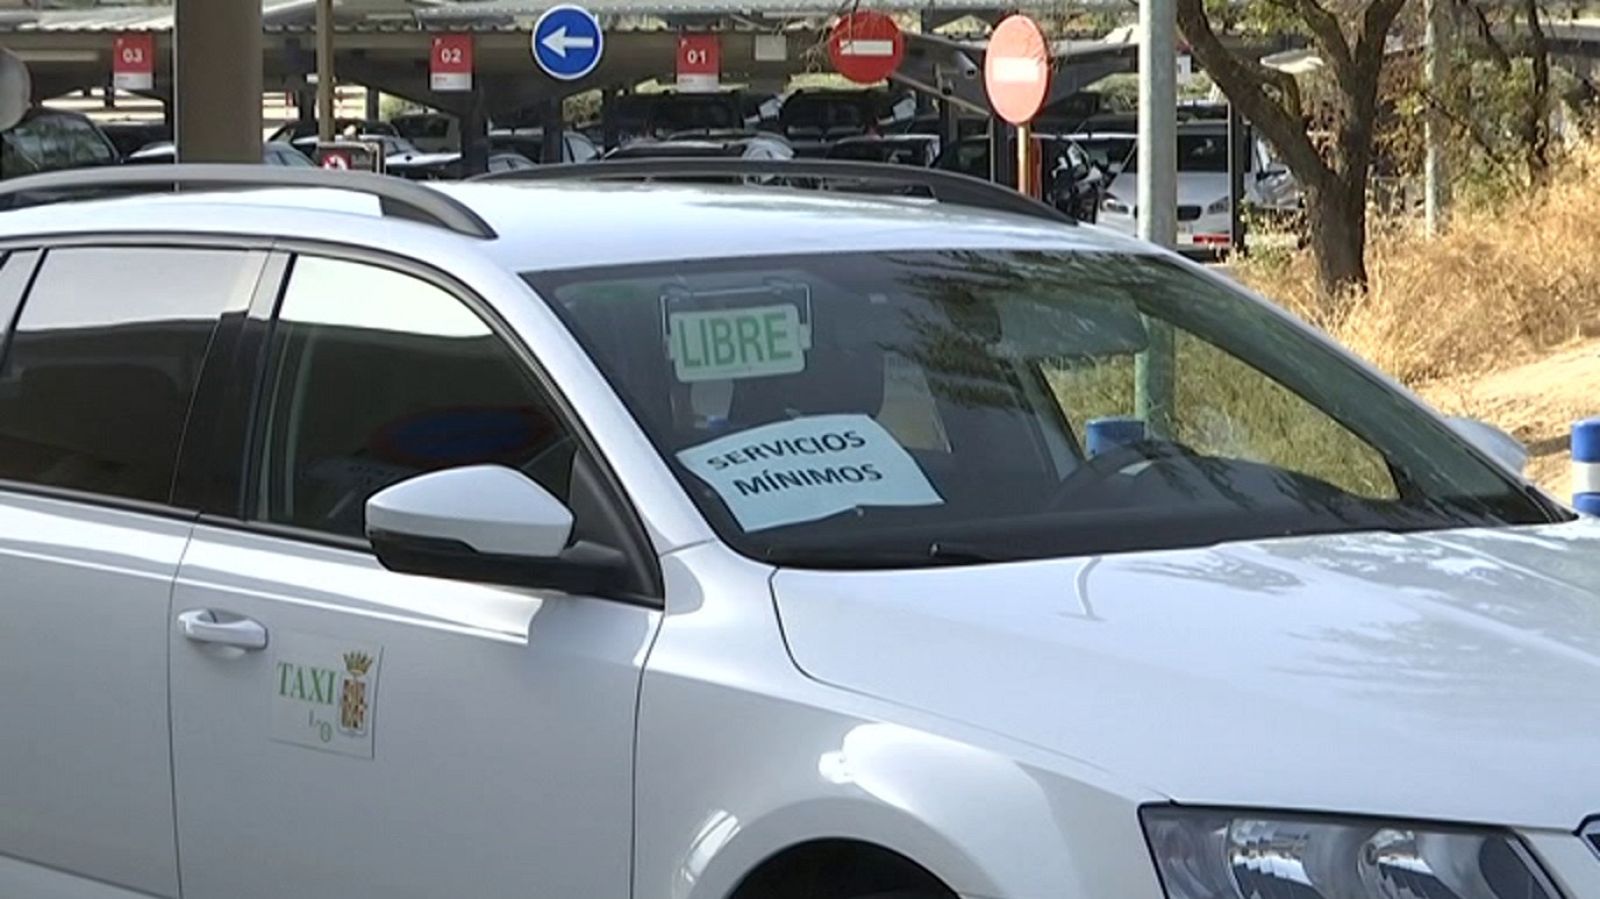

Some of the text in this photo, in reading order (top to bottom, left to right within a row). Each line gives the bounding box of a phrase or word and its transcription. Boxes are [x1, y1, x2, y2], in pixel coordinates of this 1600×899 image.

[122, 48, 143, 63] 03
[441, 48, 461, 64] 02
[687, 49, 706, 64] 01
[678, 312, 793, 368] LIBRE
[706, 430, 866, 471] SERVICIOS
[733, 462, 884, 497] MÍNIMOS
[277, 661, 336, 705] TAXI
